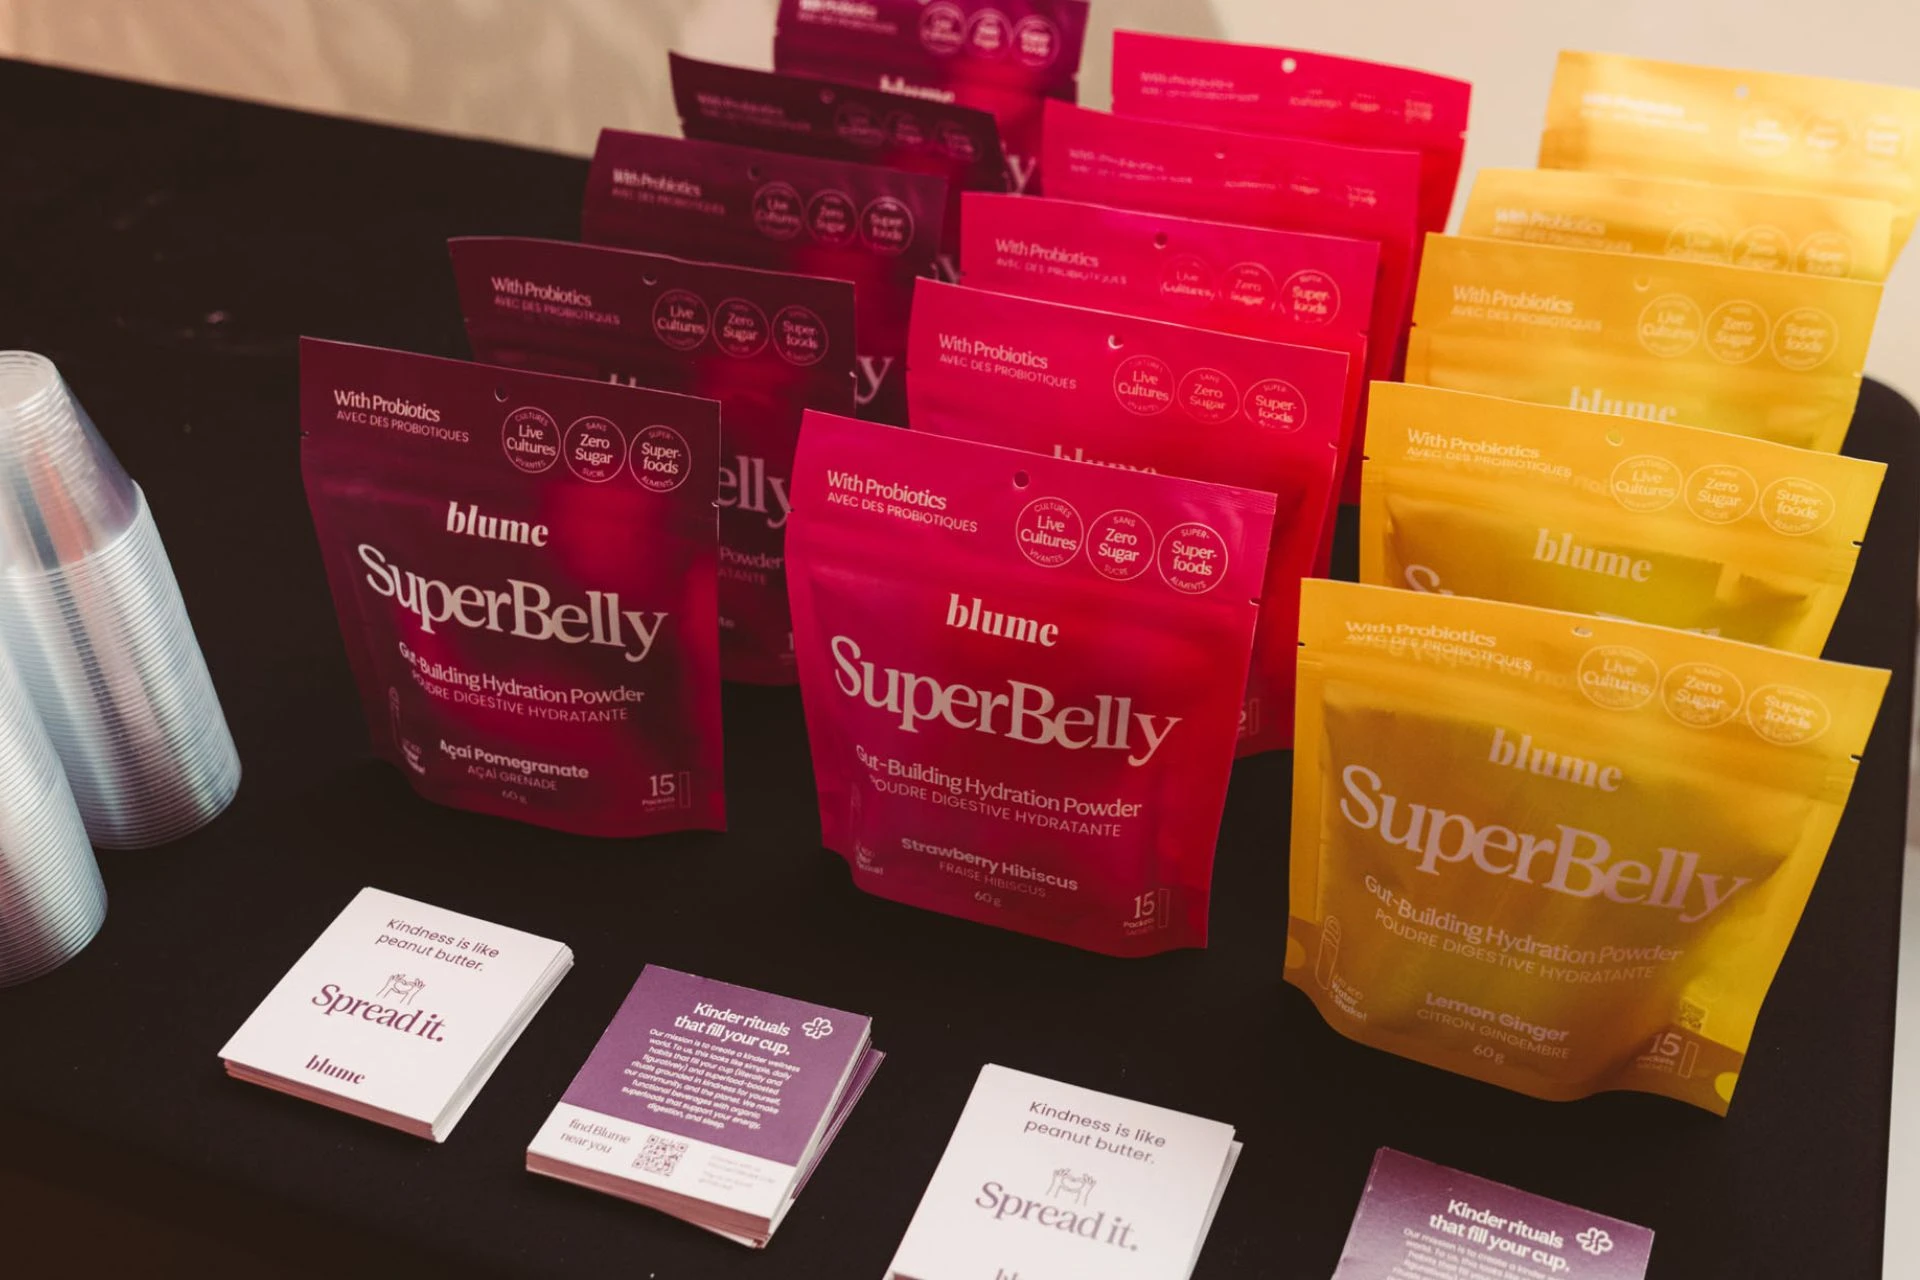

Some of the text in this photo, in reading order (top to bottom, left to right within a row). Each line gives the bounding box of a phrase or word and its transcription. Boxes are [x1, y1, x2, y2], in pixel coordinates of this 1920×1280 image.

[995, 238, 1099, 268] With Probiotics
[491, 277, 592, 307] With Probiotics
[939, 333, 1048, 370] With Probiotics
[939, 354, 1077, 390] AVEC DES PROBIOTIQUES
[1133, 370, 1159, 386] Live
[334, 389, 440, 422] With Probiotics
[1118, 382, 1169, 402] Cultures
[1189, 395, 1225, 411] Sugar
[1194, 383, 1223, 399] Zero
[337, 410, 470, 443] AVEC DES PROBIOTIQUES
[518, 424, 544, 440] Live
[1258, 408, 1294, 424] foods
[506, 437, 556, 457] Cultures
[575, 447, 613, 466] Sugar
[580, 433, 610, 449] Zero
[641, 442, 682, 460] Super-
[1407, 427, 1541, 458] With Probiotics
[643, 456, 679, 475] foods
[827, 469, 947, 511] With Probiotics
[1615, 480, 1675, 498] Cultures
[1697, 490, 1742, 508] Sugar
[1704, 478, 1740, 493] Zero
[446, 500, 549, 547] blume
[827, 492, 978, 534] AVEC DES PROBIOTIQUES
[1037, 515, 1065, 532] Live
[1775, 503, 1819, 520] foods
[1020, 529, 1077, 552] Cultures
[1098, 543, 1140, 564] Sugar
[1104, 528, 1137, 547] Zero
[1171, 541, 1217, 561] Super-
[1172, 558, 1213, 577] foods
[1533, 528, 1652, 582] blume
[358, 543, 669, 662] SuperBelly
[946, 593, 1059, 647] blume
[1345, 621, 1497, 648] With Probiotics
[399, 641, 645, 706] Gut-Building Hydration Powder
[1684, 675, 1723, 694] Zero
[454, 689, 628, 722] DIGESTIVE HYDRATANTE
[831, 635, 1183, 767] SuperBelly
[1676, 688, 1726, 711] Sugar
[474, 748, 590, 780] Pomegranate
[1487, 727, 1623, 792] blume
[650, 774, 675, 797] 15
[856, 744, 1143, 818] Gut-Building Hydration Powder
[932, 790, 1122, 837] DIGESTIVE HYDRATANTE
[1339, 763, 1754, 924] SuperBelly
[901, 837, 999, 876] Strawberry
[1001, 862, 1079, 891] Hibiscus
[939, 861, 1046, 898] FRAISE HIBISCUS
[1133, 891, 1155, 919] 15
[1364, 874, 1684, 966] Gut-Building Hydration Powder
[375, 934, 484, 972] peanut butter.
[386, 918, 500, 958] Kindness is like
[1375, 908, 1657, 984] POUDRE DIGESTIVE HYDRATANTE
[311, 984, 446, 1042] Spread it.
[693, 1002, 791, 1036] Kinder rituals
[1425, 991, 1570, 1044] Lemon Ginger
[649, 1028, 768, 1063] Our mission create kinder
[674, 1015, 791, 1056] that fill your cup.
[1416, 1007, 1570, 1060] CITRON GINGEMBRE
[1650, 1032, 1682, 1056] 15
[305, 1055, 366, 1085] blume
[648, 1046, 673, 1058] habits
[766, 1078, 783, 1087] and
[655, 1068, 694, 1082] grounded
[688, 1066, 706, 1075] and
[569, 1118, 631, 1144] find Blume
[1029, 1101, 1166, 1148] Kindness is like
[560, 1133, 612, 1153] near you
[1023, 1120, 1156, 1165] peanut butter.
[975, 1181, 1138, 1251] Spread it.
[1447, 1199, 1564, 1249] Kinder rituals
[1429, 1214, 1464, 1238] that
[1467, 1224, 1488, 1244] fill
[1486, 1234, 1531, 1257] your
[1532, 1247, 1571, 1272] cup.
